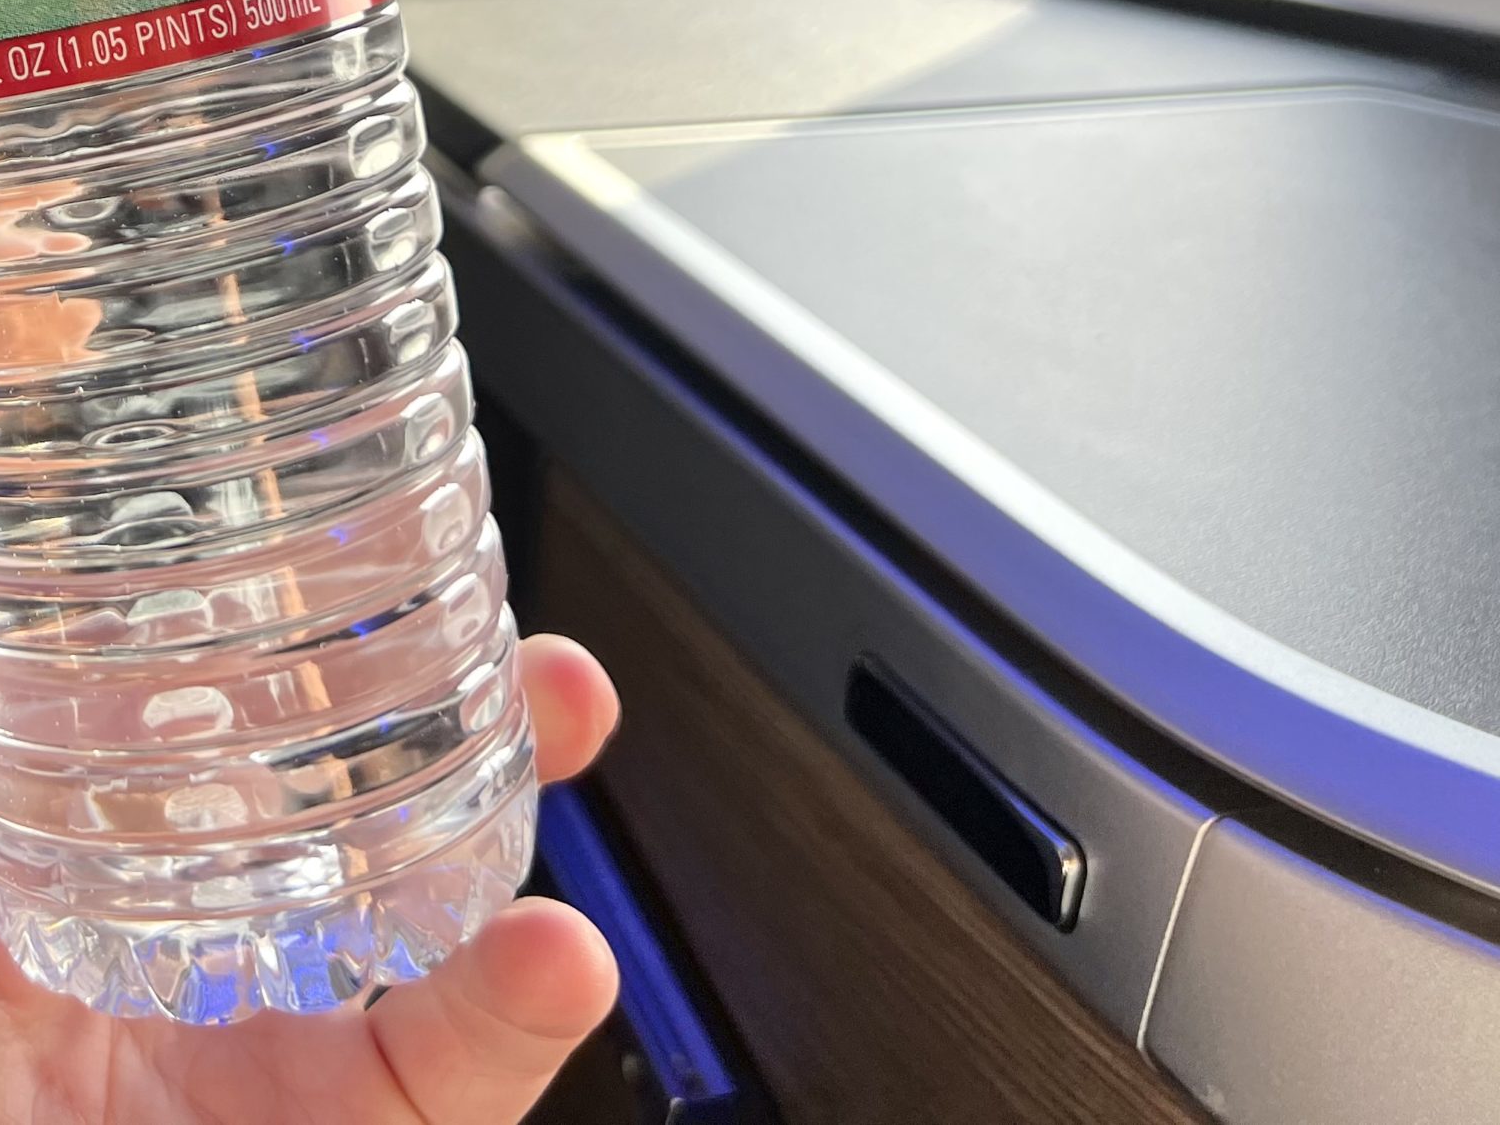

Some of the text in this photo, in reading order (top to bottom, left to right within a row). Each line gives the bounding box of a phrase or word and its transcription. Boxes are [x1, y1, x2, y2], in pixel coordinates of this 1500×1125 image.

[8, 42, 51, 81] OZ
[57, 26, 128, 73] (1.05
[135, 0, 237, 56] PINTS)
